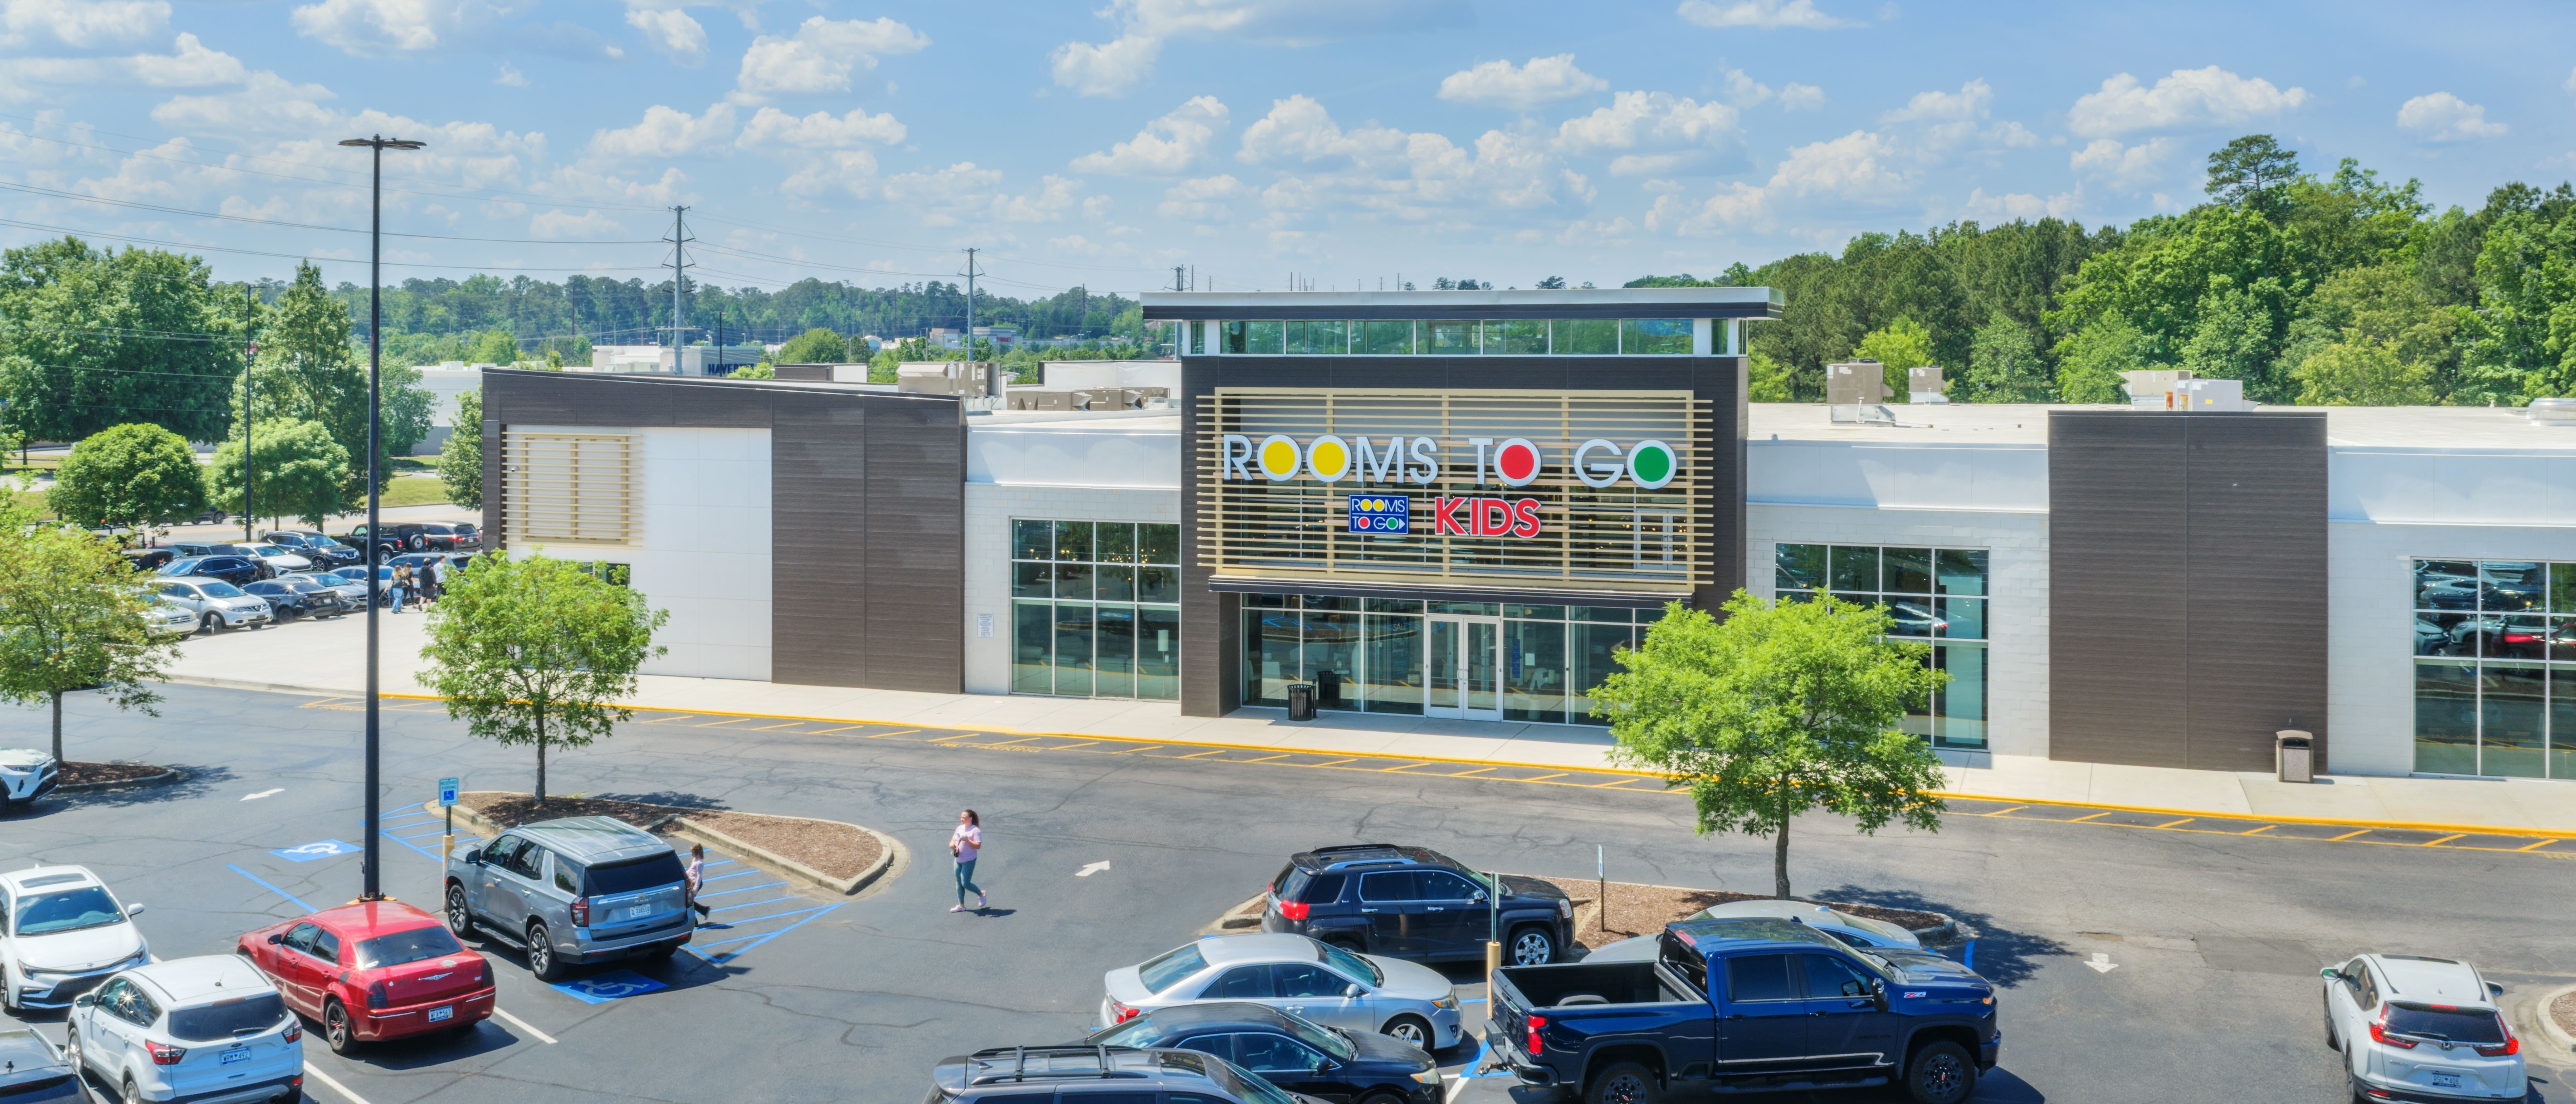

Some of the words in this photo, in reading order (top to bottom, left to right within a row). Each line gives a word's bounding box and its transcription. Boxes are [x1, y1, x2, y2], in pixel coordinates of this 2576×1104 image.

[1224, 434, 1438, 484] ROOMS
[1469, 438, 1542, 487] TO
[1574, 439, 1677, 489] GO
[1352, 499, 1405, 512] ROOMS
[1352, 516, 1370, 529] TO
[1374, 517, 1399, 530] GO
[1435, 497, 1541, 538] KIDS
[1393, 622, 1407, 631] SALE
